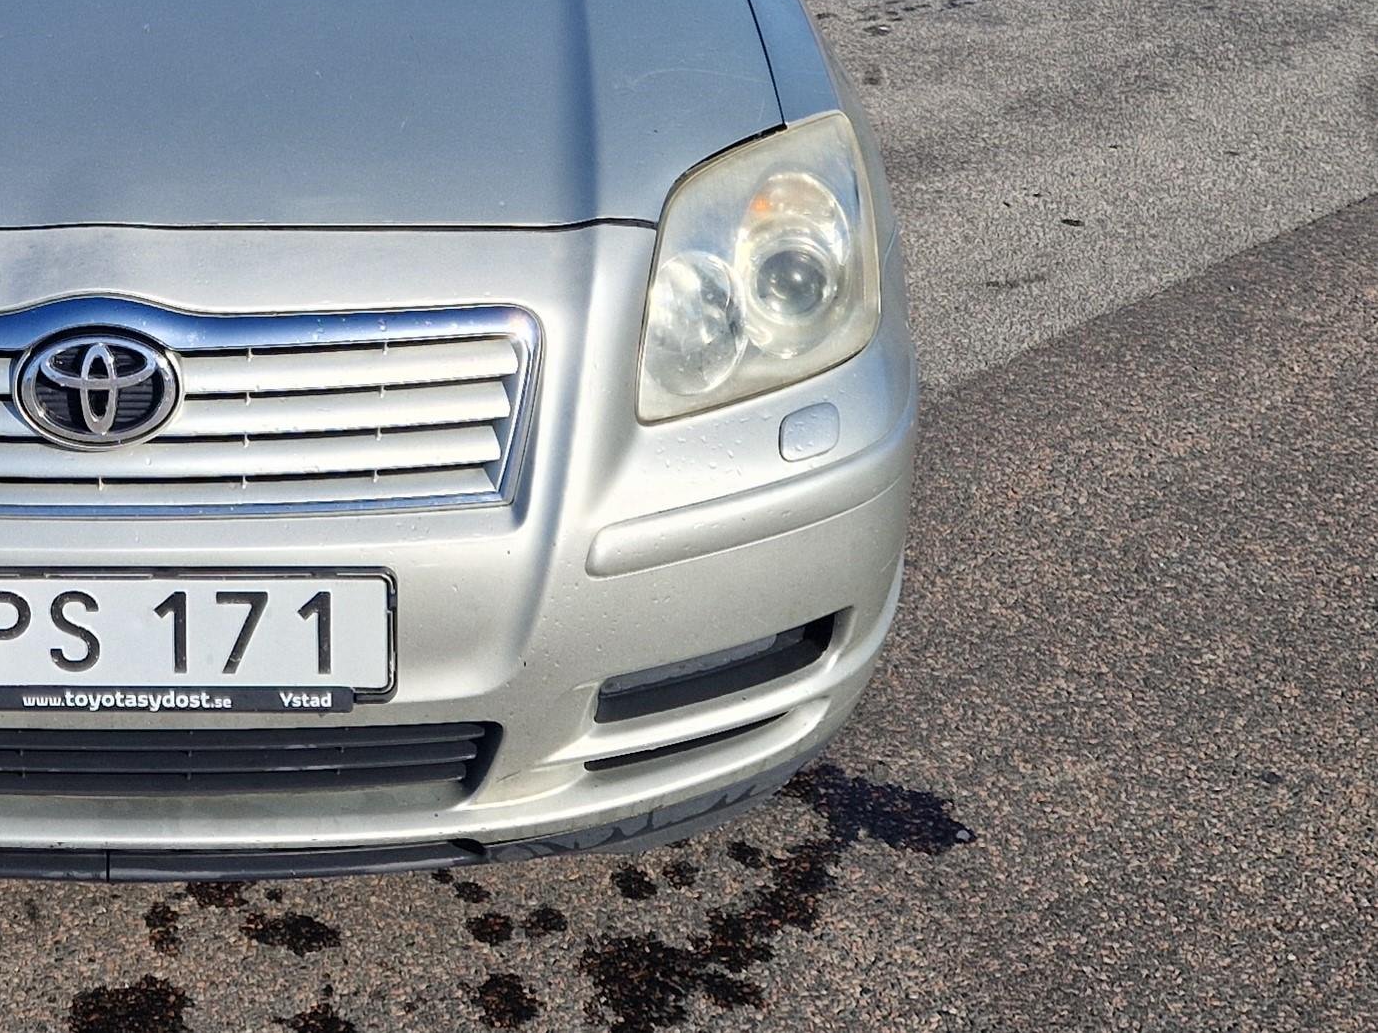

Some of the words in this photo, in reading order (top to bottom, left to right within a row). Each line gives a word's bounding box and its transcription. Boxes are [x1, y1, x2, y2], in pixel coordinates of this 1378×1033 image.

[152, 590, 332, 675] 171
[22, 690, 232, 712] www.toyotasydost.se
[279, 692, 332, 708] Ystad
